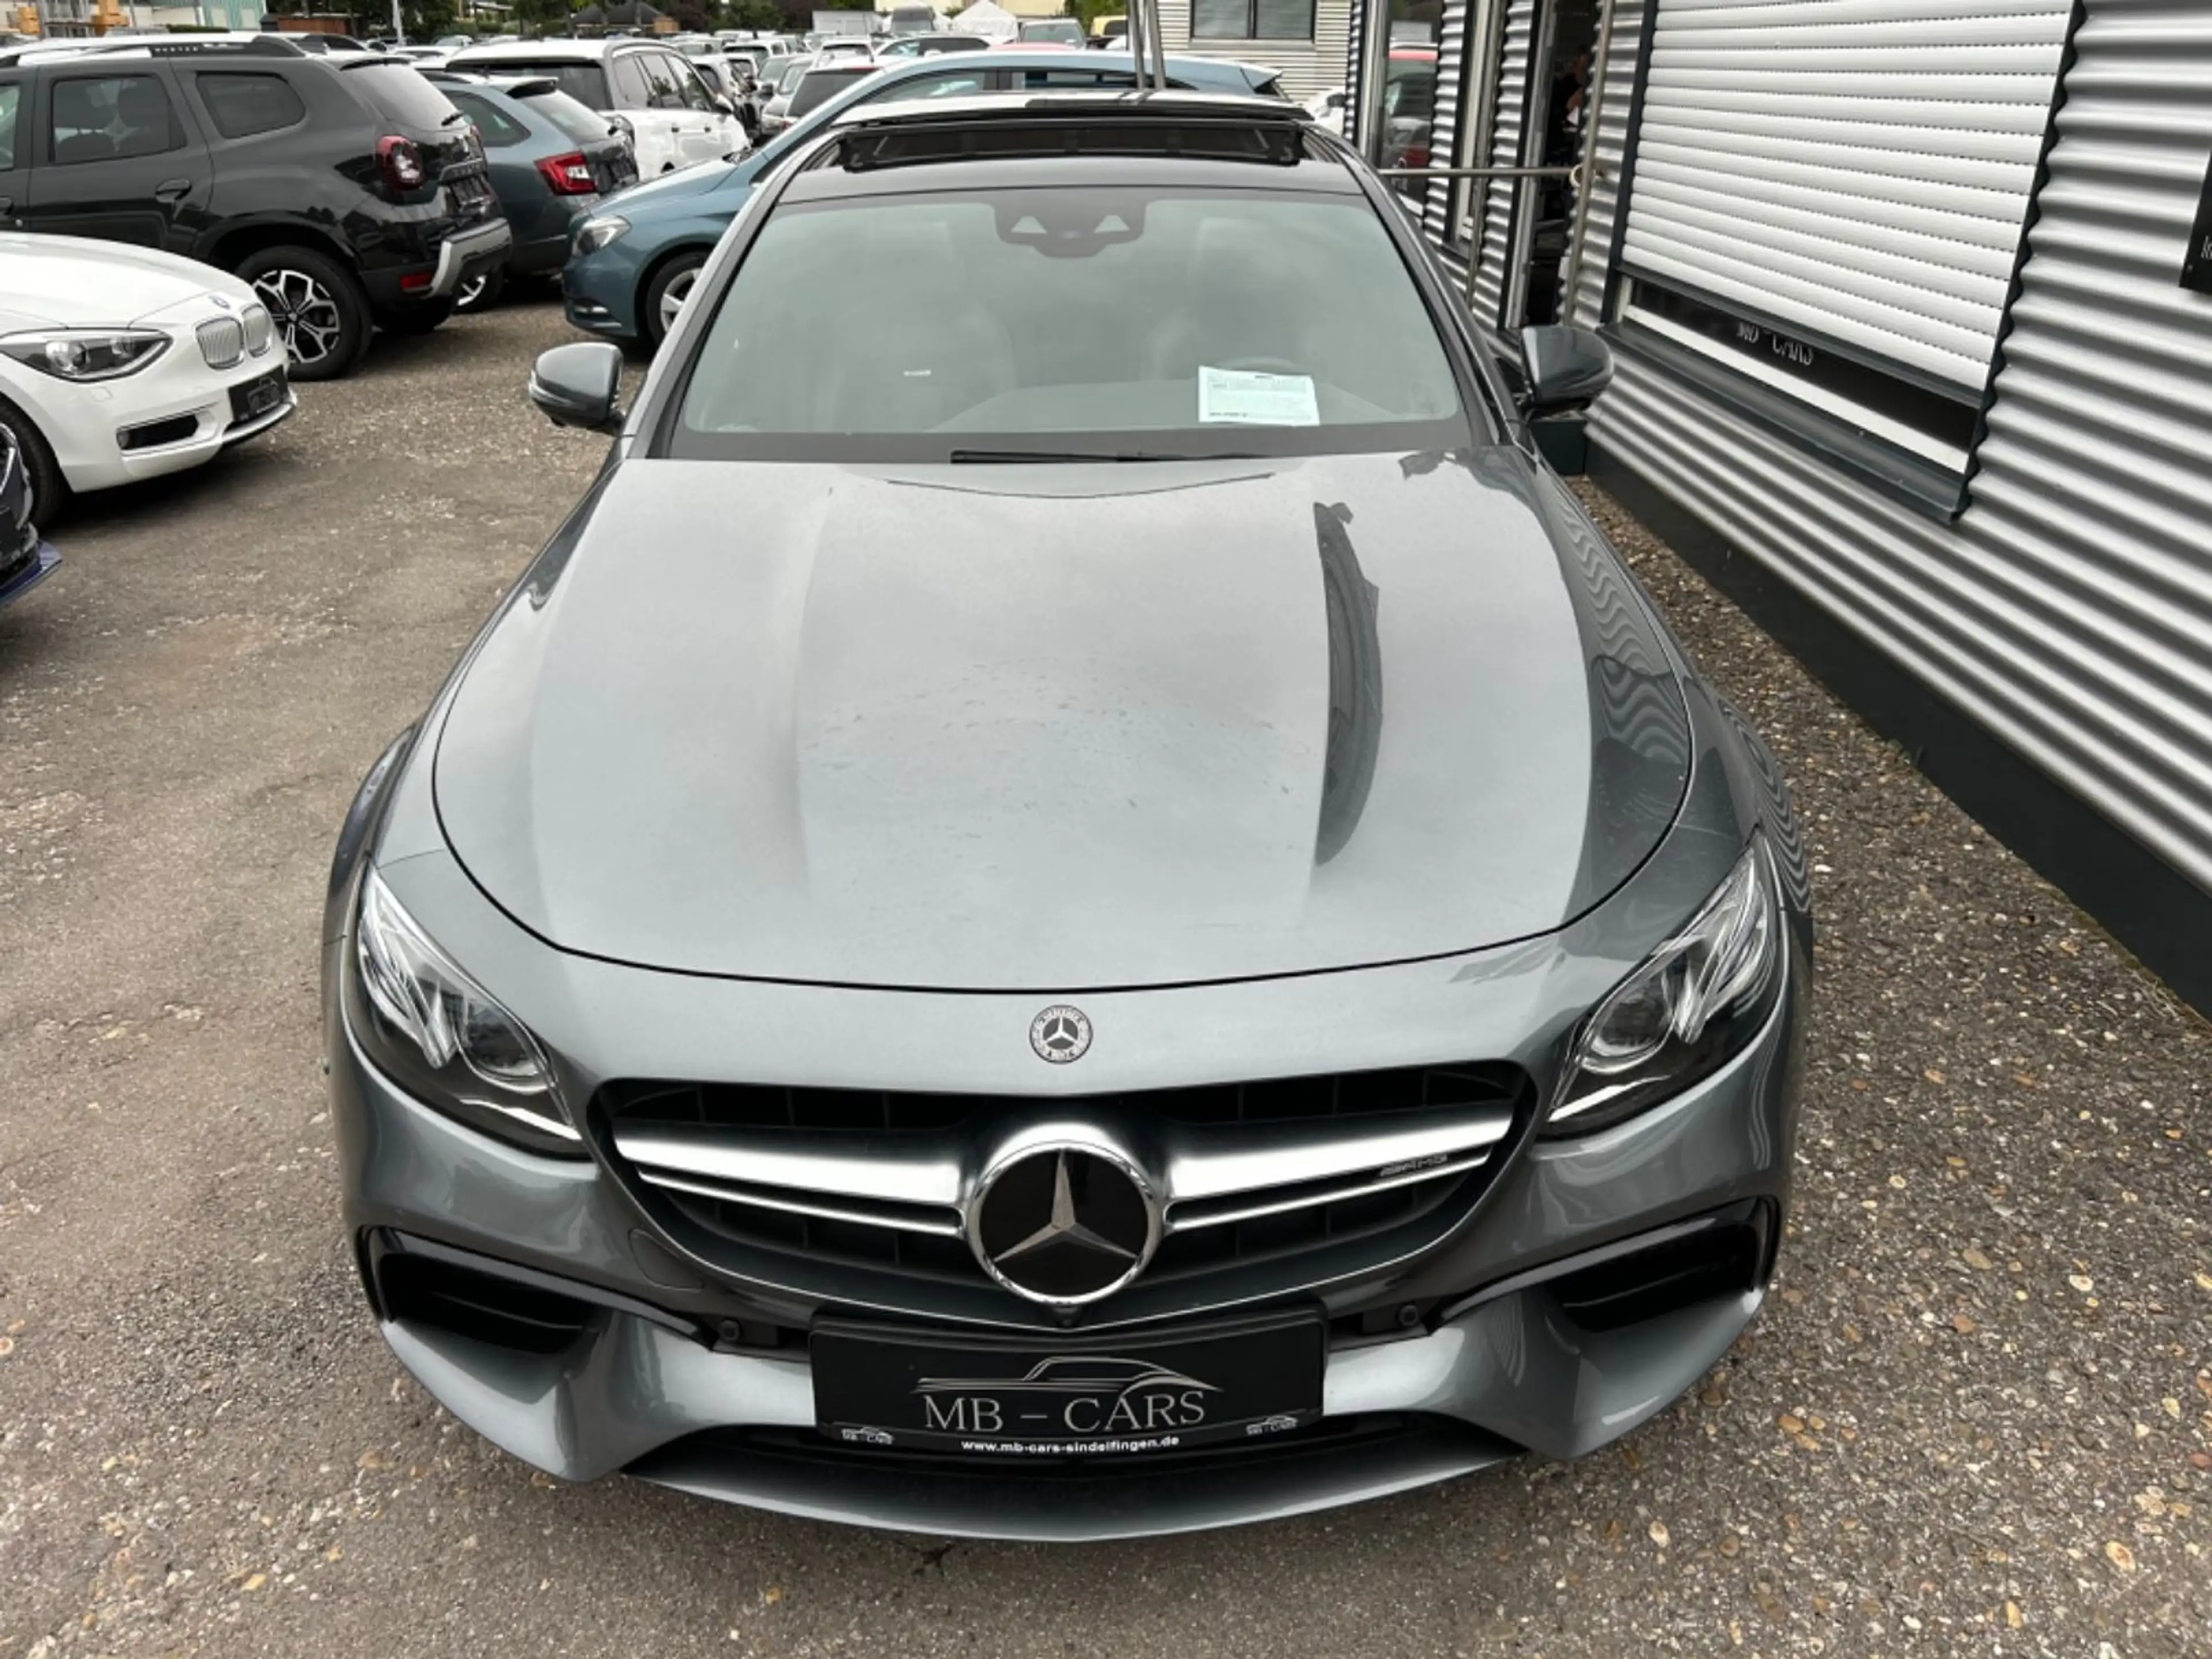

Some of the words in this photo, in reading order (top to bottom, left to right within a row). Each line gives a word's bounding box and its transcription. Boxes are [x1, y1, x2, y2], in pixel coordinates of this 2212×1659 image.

[923, 1394, 1004, 1433] MB
[1063, 1390, 1206, 1433] CARS
[961, 1435, 1180, 1453] www.mb-cars-sindelfingen.de
